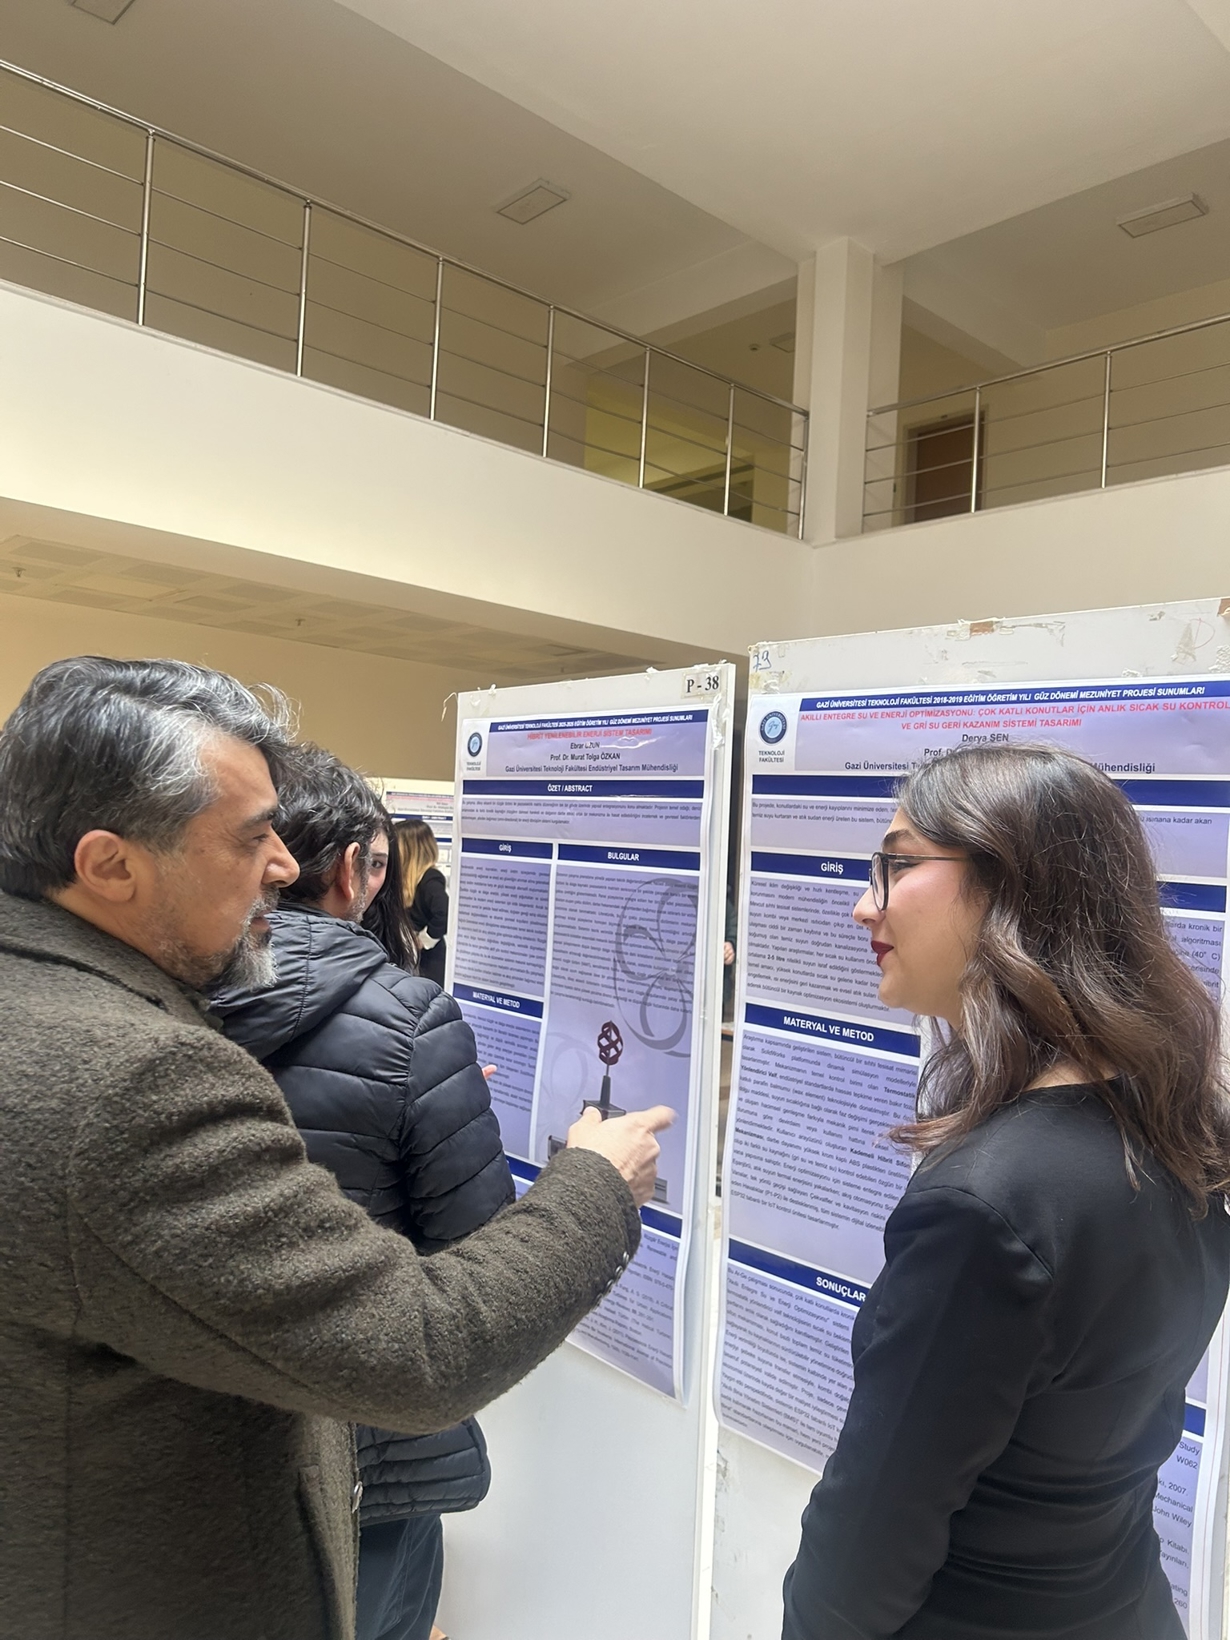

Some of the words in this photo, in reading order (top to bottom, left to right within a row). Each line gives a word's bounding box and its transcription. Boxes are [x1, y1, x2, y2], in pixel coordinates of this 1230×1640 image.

[686, 678, 694, 693] P
[704, 676, 719, 691] 38
[816, 700, 830, 708] GAZİ
[830, 698, 867, 708] ÜNİVERSİTESİ
[868, 697, 900, 707] TEKNOLOJİ
[900, 695, 932, 705] FAKÜLTESİ
[964, 694, 986, 703] EĞİTİM
[987, 692, 1018, 702] ÖĞRETİM
[1018, 693, 1031, 701] YILI
[1034, 691, 1050, 700] GÜZ
[1050, 690, 1079, 700] DÖNEMİ
[1080, 688, 1121, 699] MEZUNİYET
[1122, 687, 1156, 698] PROJESİ
[1158, 686, 1206, 696] SUNUMLARI
[800, 712, 822, 721] AKILLI
[823, 712, 856, 720] ENTEGRE
[858, 712, 868, 720] SU
[880, 709, 907, 718] ENERJİ
[909, 706, 974, 718] OPTİMİZASYONU:
[978, 708, 996, 717] ÇOK
[999, 707, 1022, 716] KATLI
[1025, 706, 1074, 714] KONUTLAR
[1077, 704, 1096, 714] İÇİN
[1098, 704, 1126, 713] ANLIK
[1130, 703, 1159, 712] SICAK
[1162, 702, 1176, 711] SU
[669, 714, 693, 722] SUNUMLARI
[902, 722, 911, 730] VE
[913, 720, 927, 730] GRİ
[928, 722, 940, 730] SU
[942, 719, 961, 729] GERİ
[962, 720, 1000, 729] KAZANIM
[1002, 718, 1037, 728] SİSTEMİ
[1040, 718, 1082, 727] TASARIMI
[962, 734, 987, 744] Derya
[570, 742, 584, 750] Ebrar
[586, 753, 600, 762] Tolga
[600, 752, 620, 760] ÖZKAN
[924, 748, 943, 757] Prof.
[516, 764, 542, 772] Üniversitesi
[543, 765, 564, 773] Teknoloji
[588, 764, 618, 773] Endüstriyel
[642, 763, 678, 773] Mühendisliği
[844, 762, 862, 770] Gazi
[863, 760, 909, 770] Üniversitesi
[1093, 761, 1156, 774] ühendisliği
[547, 784, 561, 792] ÖZET
[564, 785, 593, 793] ABSTRACT
[1173, 816, 1193, 825] kadar
[1194, 816, 1212, 826] akan
[499, 843, 512, 853] GİRİŞ
[607, 852, 640, 862] BULGULAR
[820, 861, 844, 875] GİRİŞ
[1188, 923, 1210, 932] kronik
[1212, 924, 1222, 932] bir
[1181, 936, 1221, 946] algoritması
[472, 991, 496, 1004] MATERYAL
[496, 996, 503, 1004] VE
[503, 998, 520, 1009] METOD
[783, 1016, 827, 1034] MATERYAL
[828, 1024, 841, 1035] VE
[842, 1027, 874, 1042] METOD
[884, 1086, 915, 1098] Termostatik
[816, 1276, 866, 1302] SONUÇLAR
[1179, 1441, 1200, 1456] Study
[1176, 1455, 1198, 1469] W062
[1172, 1513, 1192, 1528] Wiley
